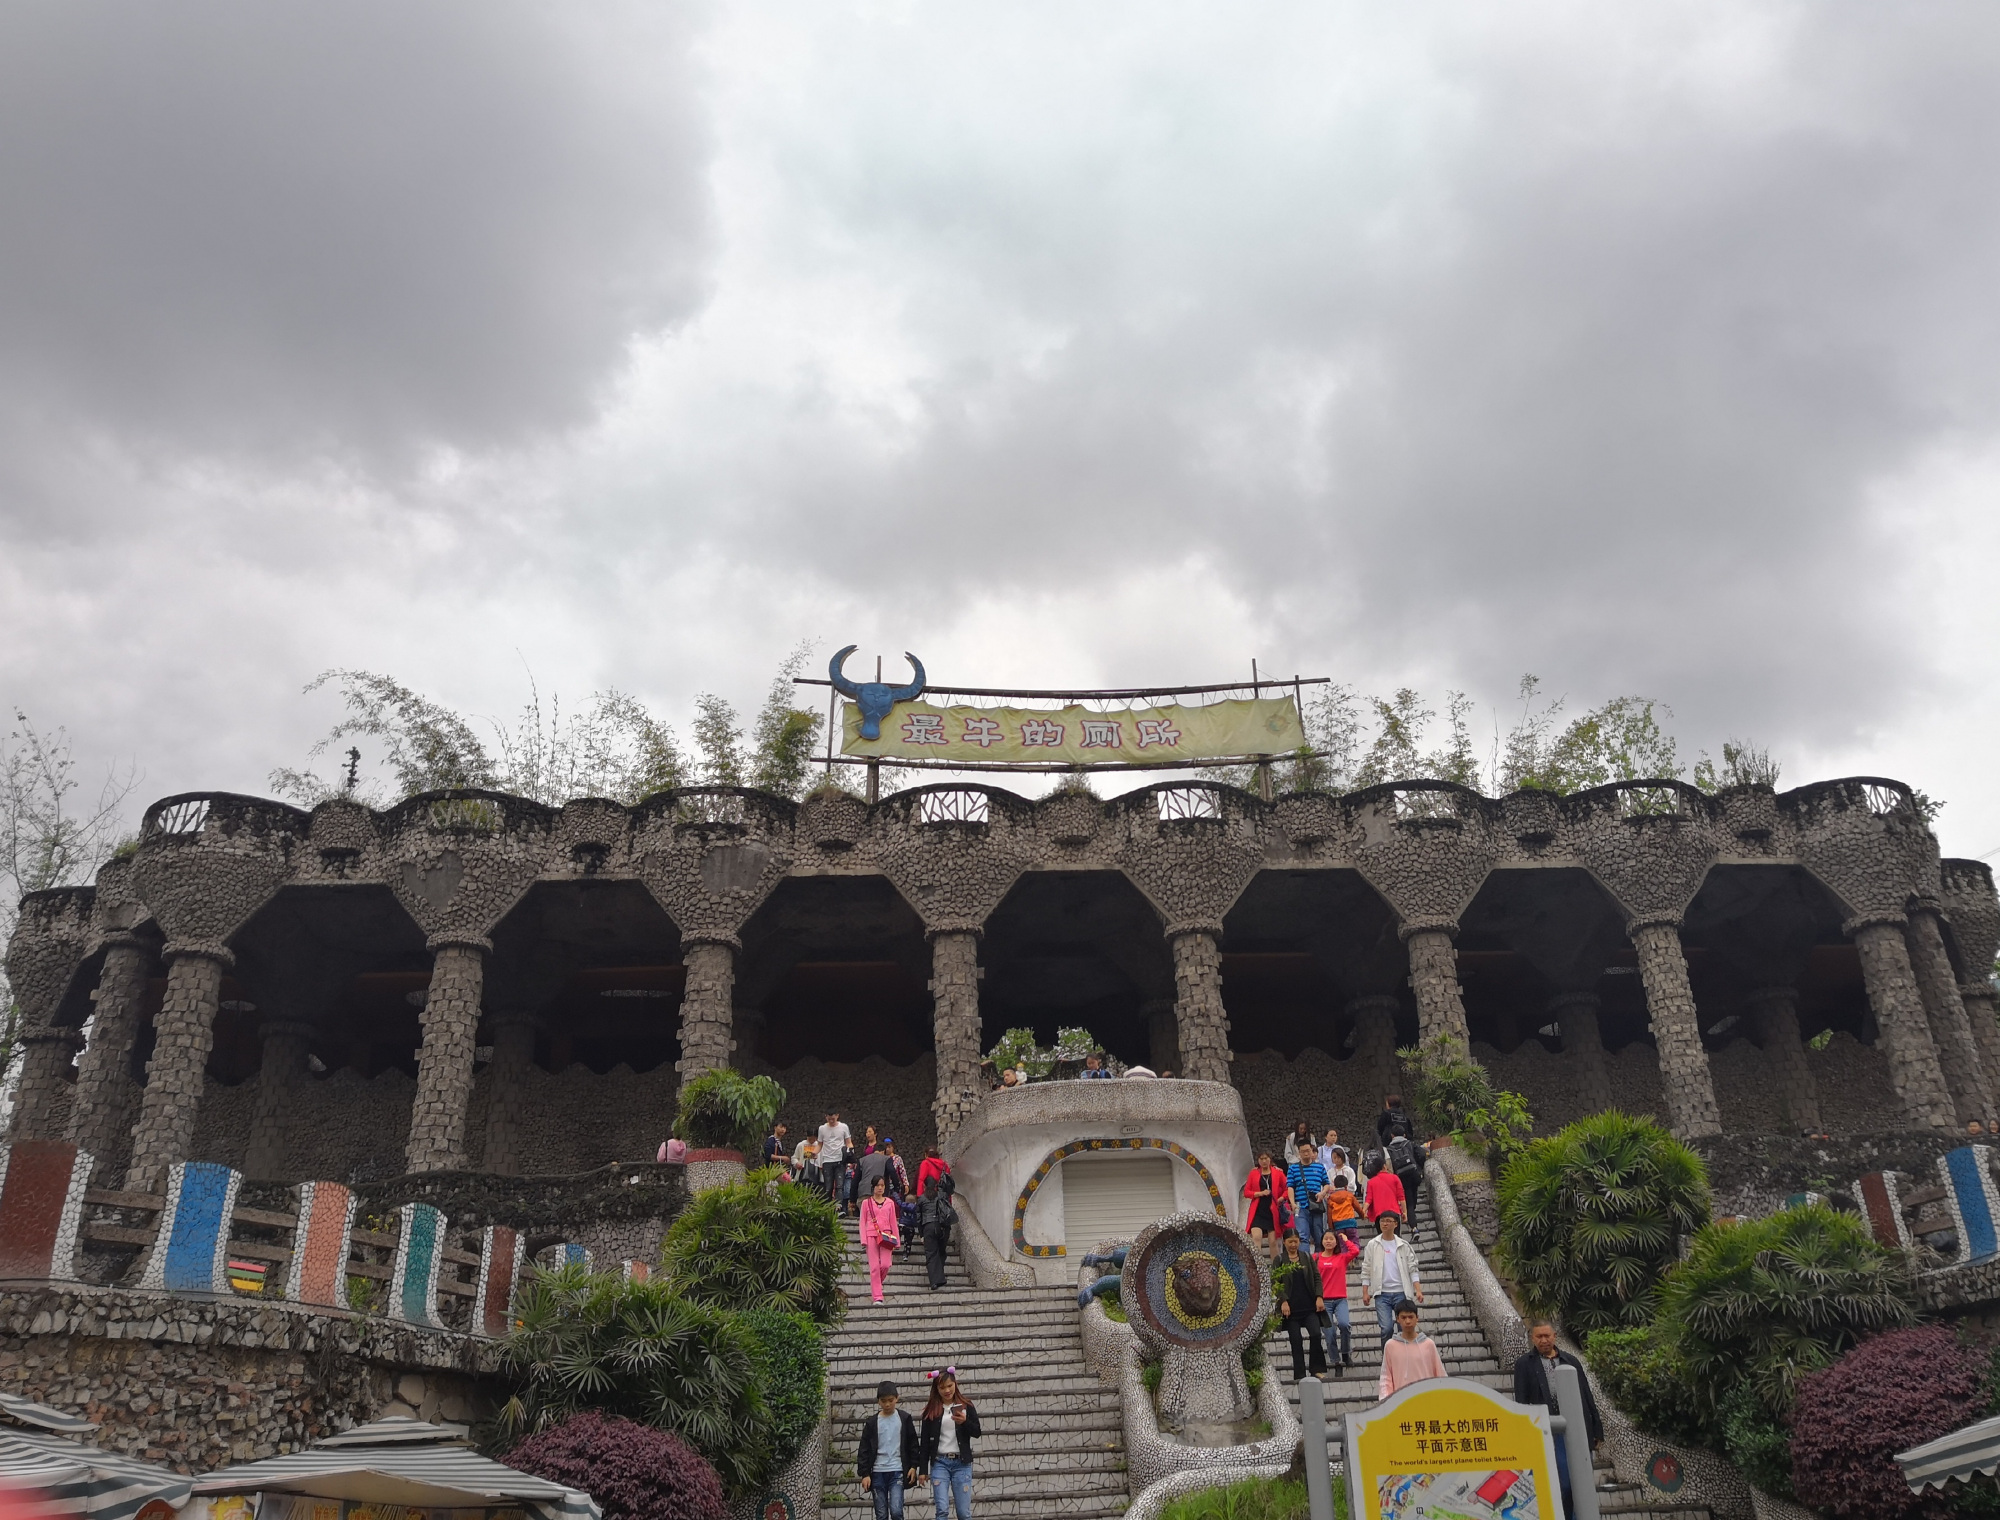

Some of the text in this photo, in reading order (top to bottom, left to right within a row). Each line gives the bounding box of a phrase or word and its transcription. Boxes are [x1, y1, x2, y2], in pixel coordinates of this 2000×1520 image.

[902, 714, 1181, 748] 最牛的厕所
[1399, 1418, 1499, 1435] 世界最大的厕所
[1416, 1437, 1487, 1453] 平面示意图
[1430, 1458, 1453, 1466] largest
